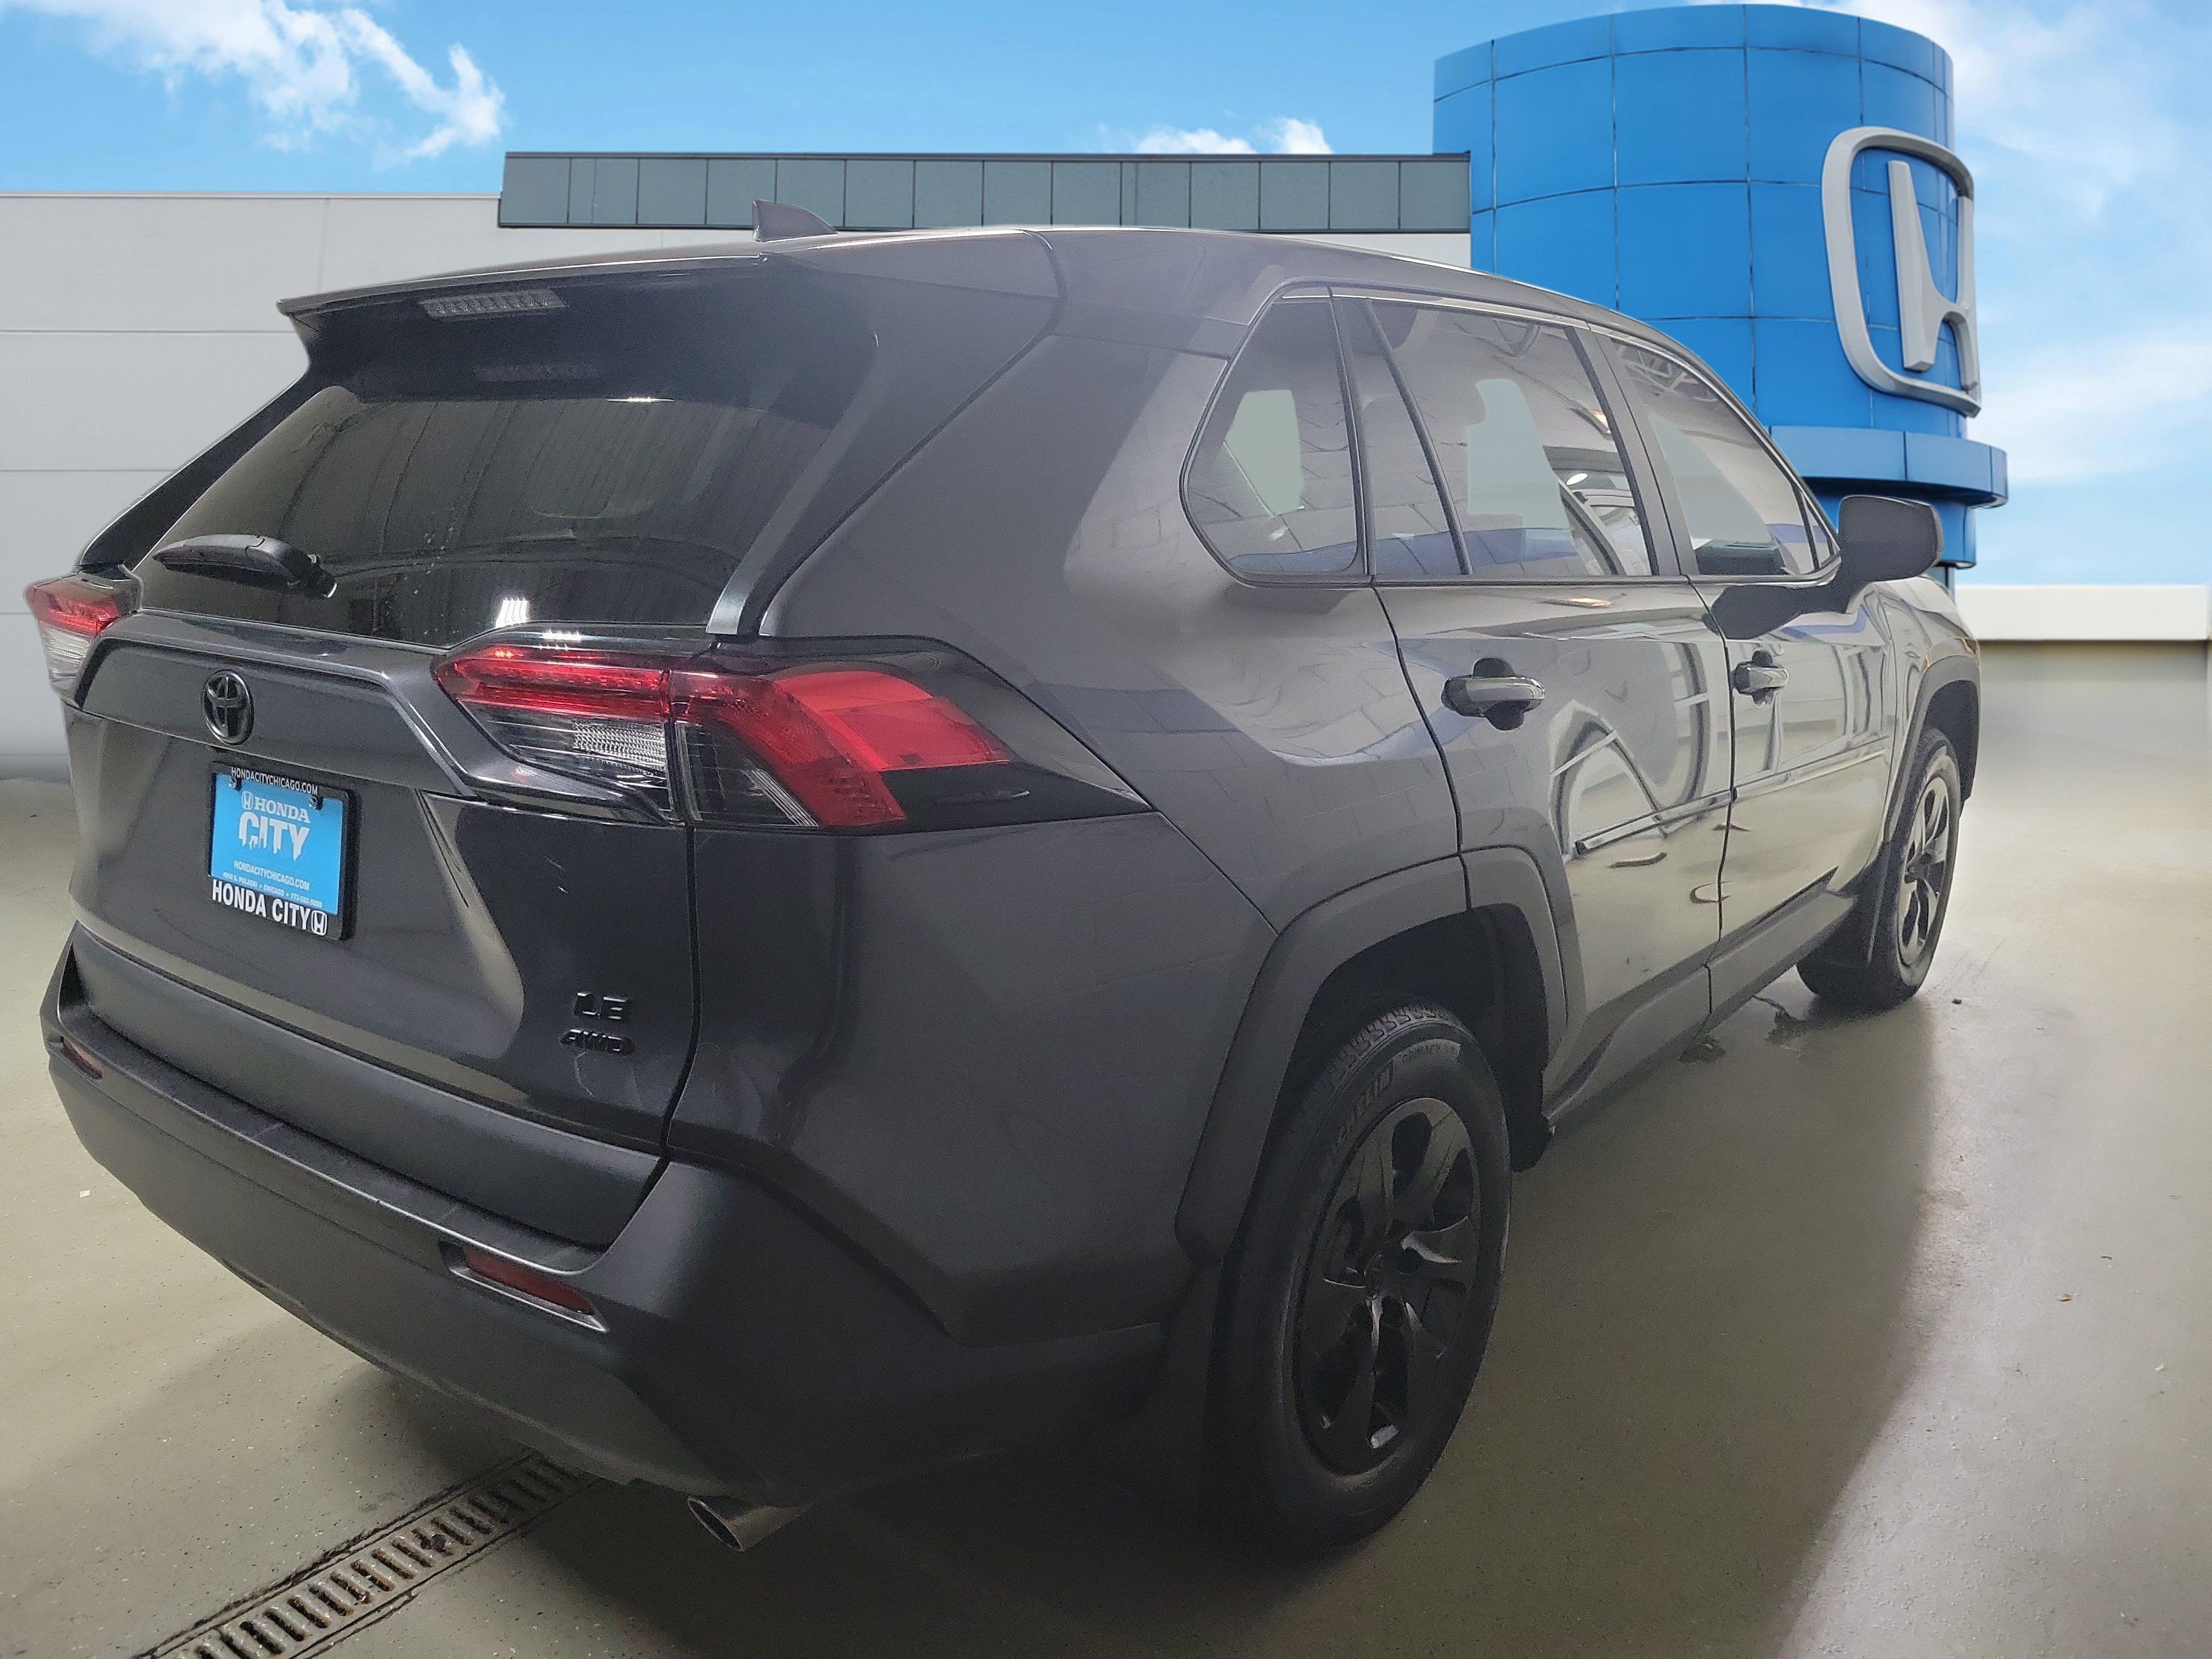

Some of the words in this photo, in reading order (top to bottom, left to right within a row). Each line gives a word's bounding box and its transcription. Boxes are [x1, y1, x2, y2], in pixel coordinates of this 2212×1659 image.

[231, 767, 318, 795] HONDACITYCHICAGO.COM
[255, 797, 311, 823] HONDA
[239, 811, 310, 861] CITY
[234, 860, 310, 891] HONDACITYCHICAGO.COM
[212, 879, 267, 917] HONDA
[272, 898, 311, 930] CITY
[574, 991, 630, 1020] LE
[561, 1029, 634, 1054] AWD
